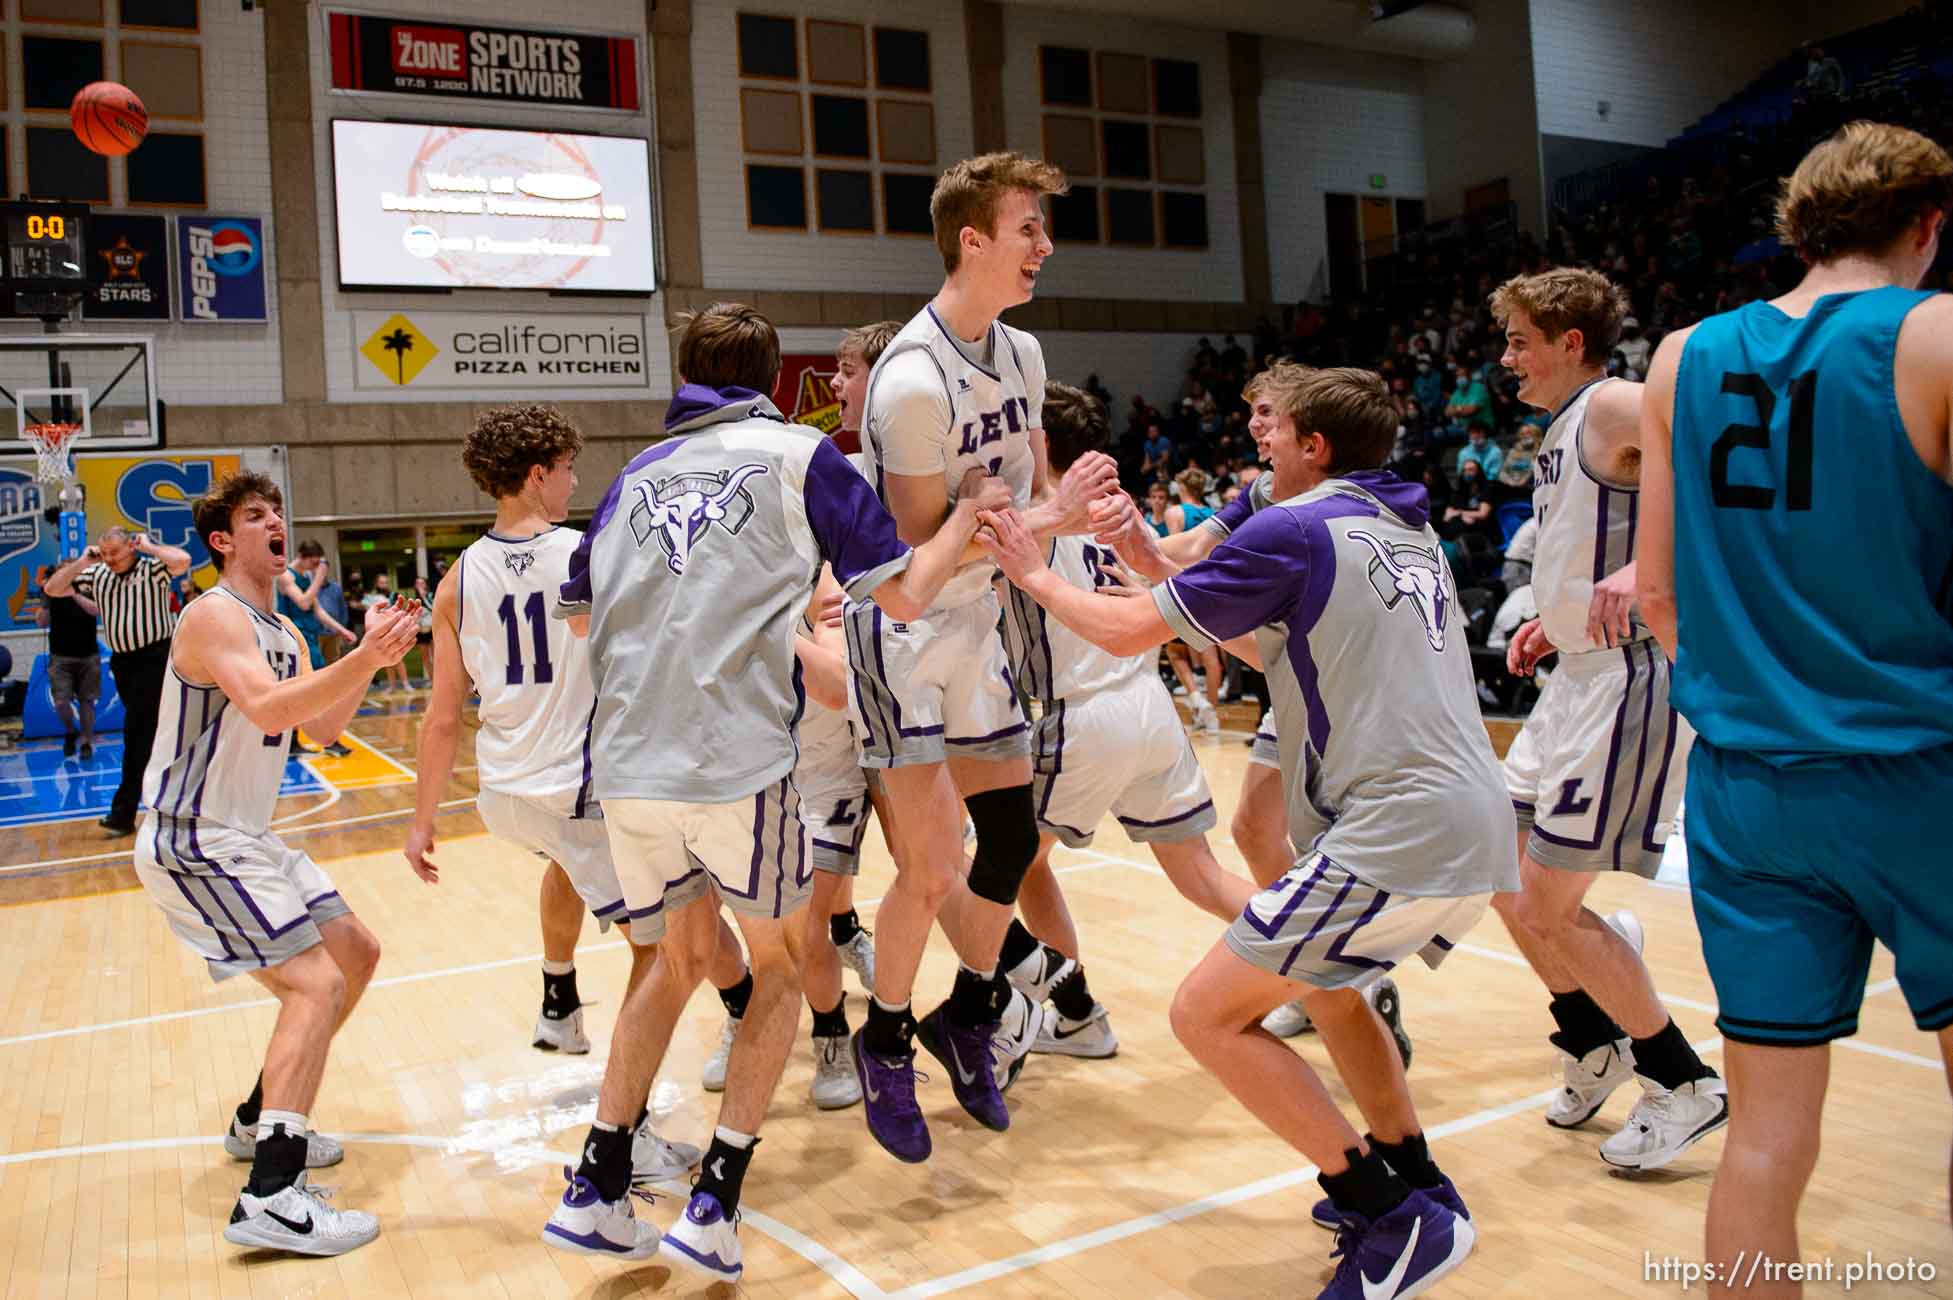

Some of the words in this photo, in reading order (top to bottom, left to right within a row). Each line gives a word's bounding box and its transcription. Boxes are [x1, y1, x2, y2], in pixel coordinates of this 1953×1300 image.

[399, 39, 461, 71] ZONE
[469, 31, 581, 73] SPORTS
[471, 66, 583, 99] NETWORK
[188, 226, 218, 320] PEPSI
[100, 287, 151, 302] STARS
[453, 326, 640, 354] california
[455, 361, 527, 374] PIZZA
[538, 361, 641, 374] KITCHEN
[1709, 369, 1817, 512] 21
[497, 590, 553, 685] 11
[826, 799, 857, 826] L
[1552, 778, 1593, 815] L
